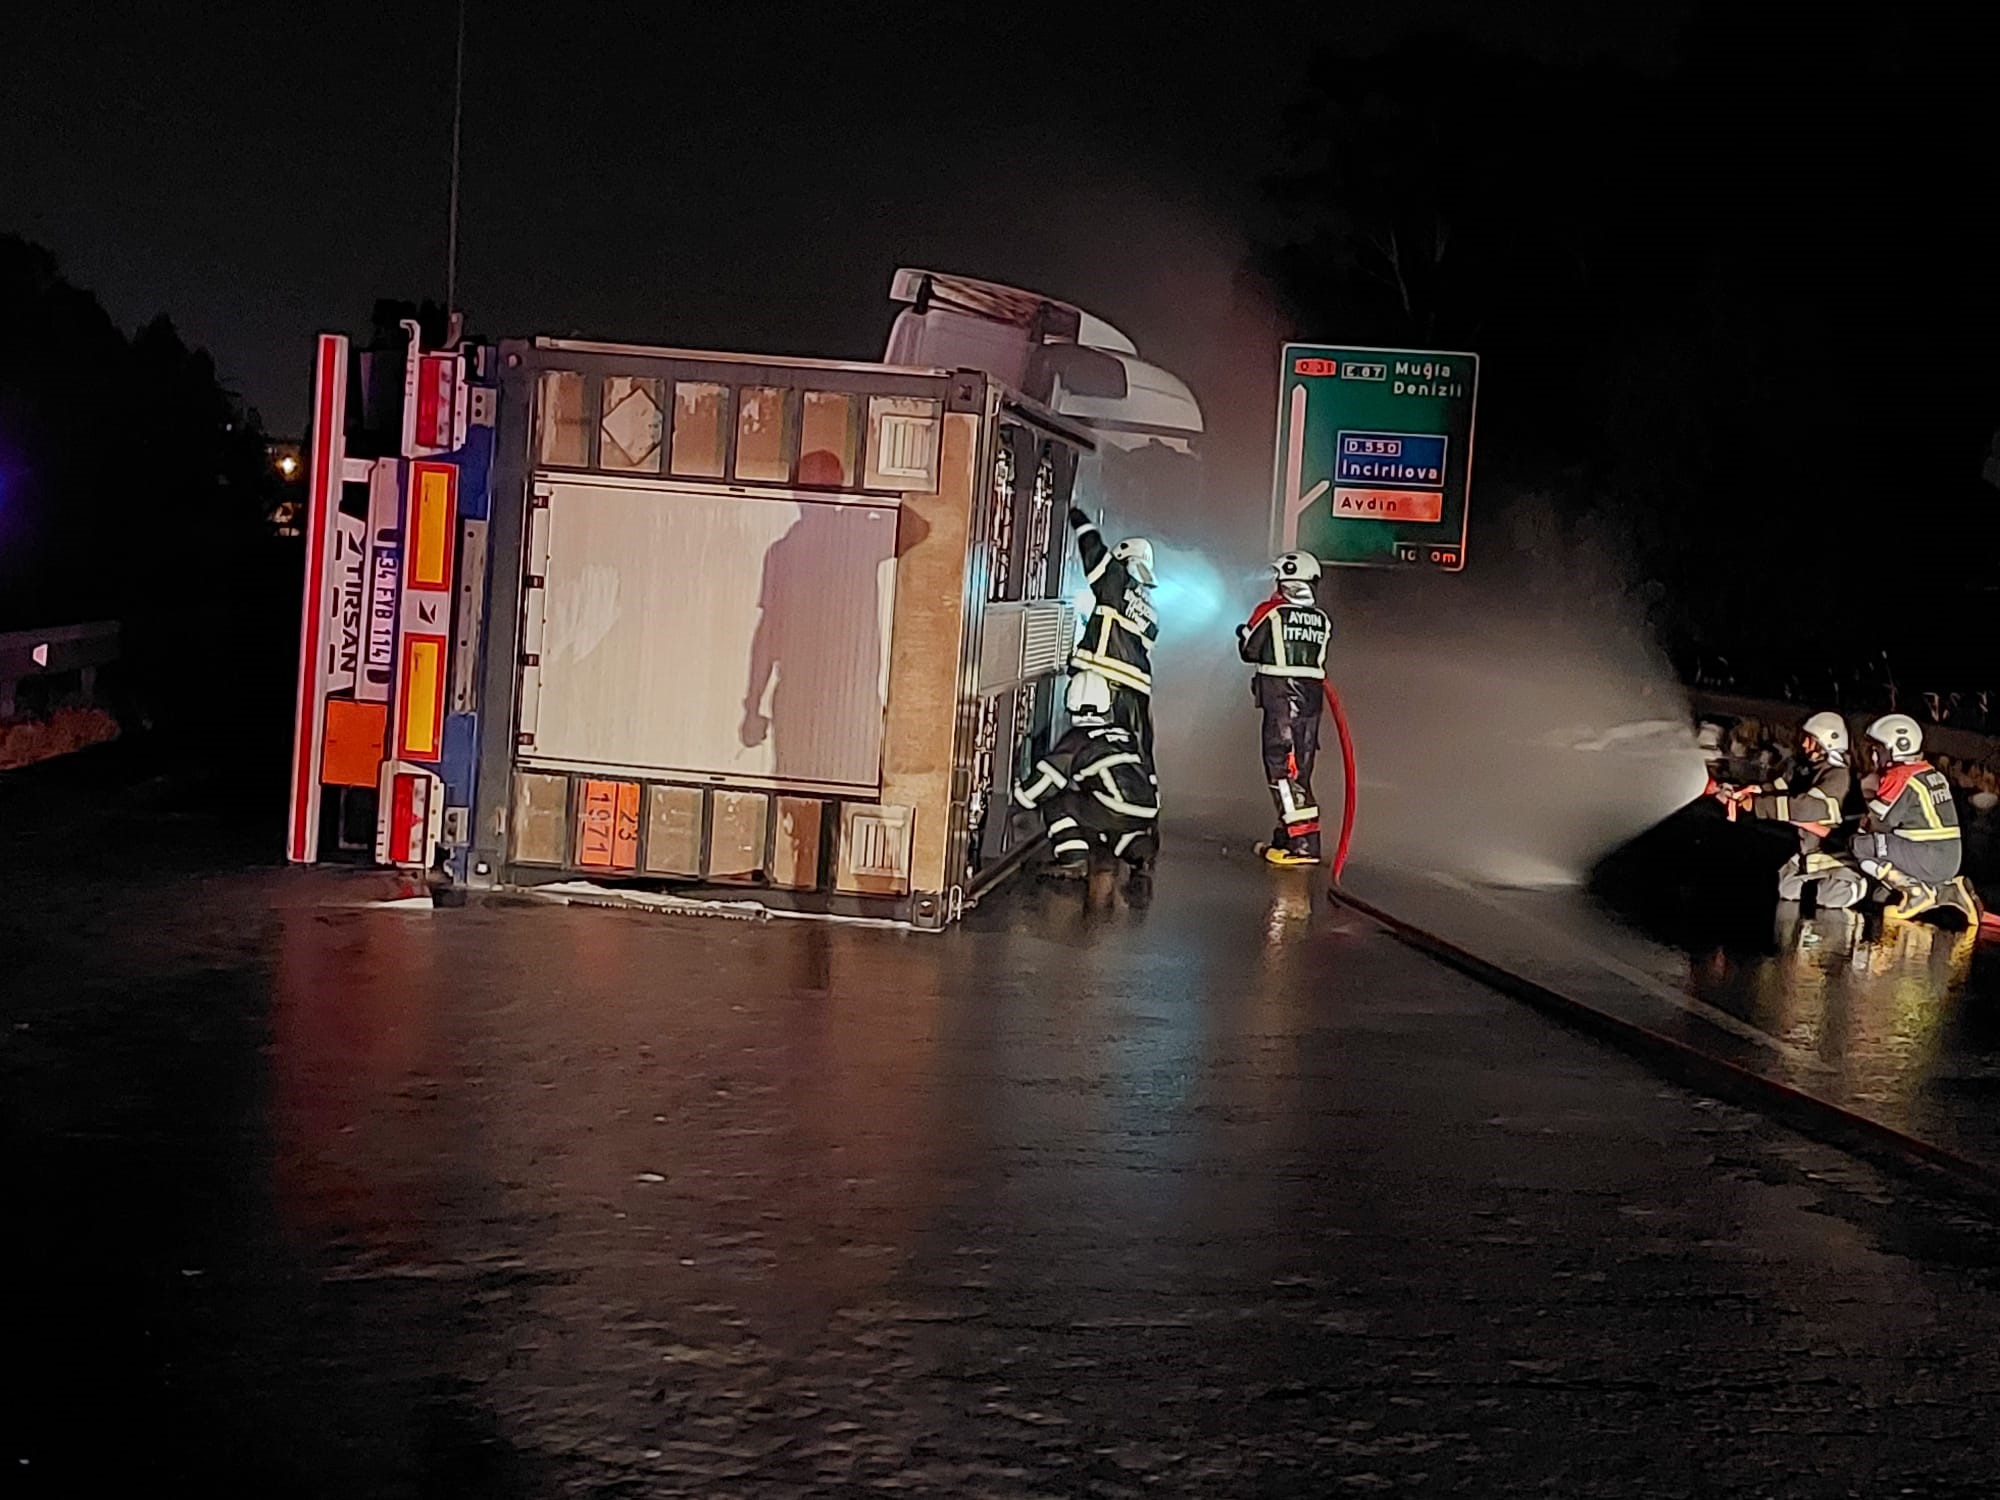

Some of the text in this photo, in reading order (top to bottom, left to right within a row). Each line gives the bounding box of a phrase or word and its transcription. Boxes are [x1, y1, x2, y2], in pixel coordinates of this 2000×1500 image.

[1395, 361, 1451, 380] Muğla
[1393, 381, 1462, 398] Denizli
[340, 560, 364, 673] TIRSAN
[371, 557, 397, 658] 34 FYB 114
[1288, 611, 1322, 627] AYDIN
[586, 792, 611, 852] 1971
[618, 810, 639, 841] 23
